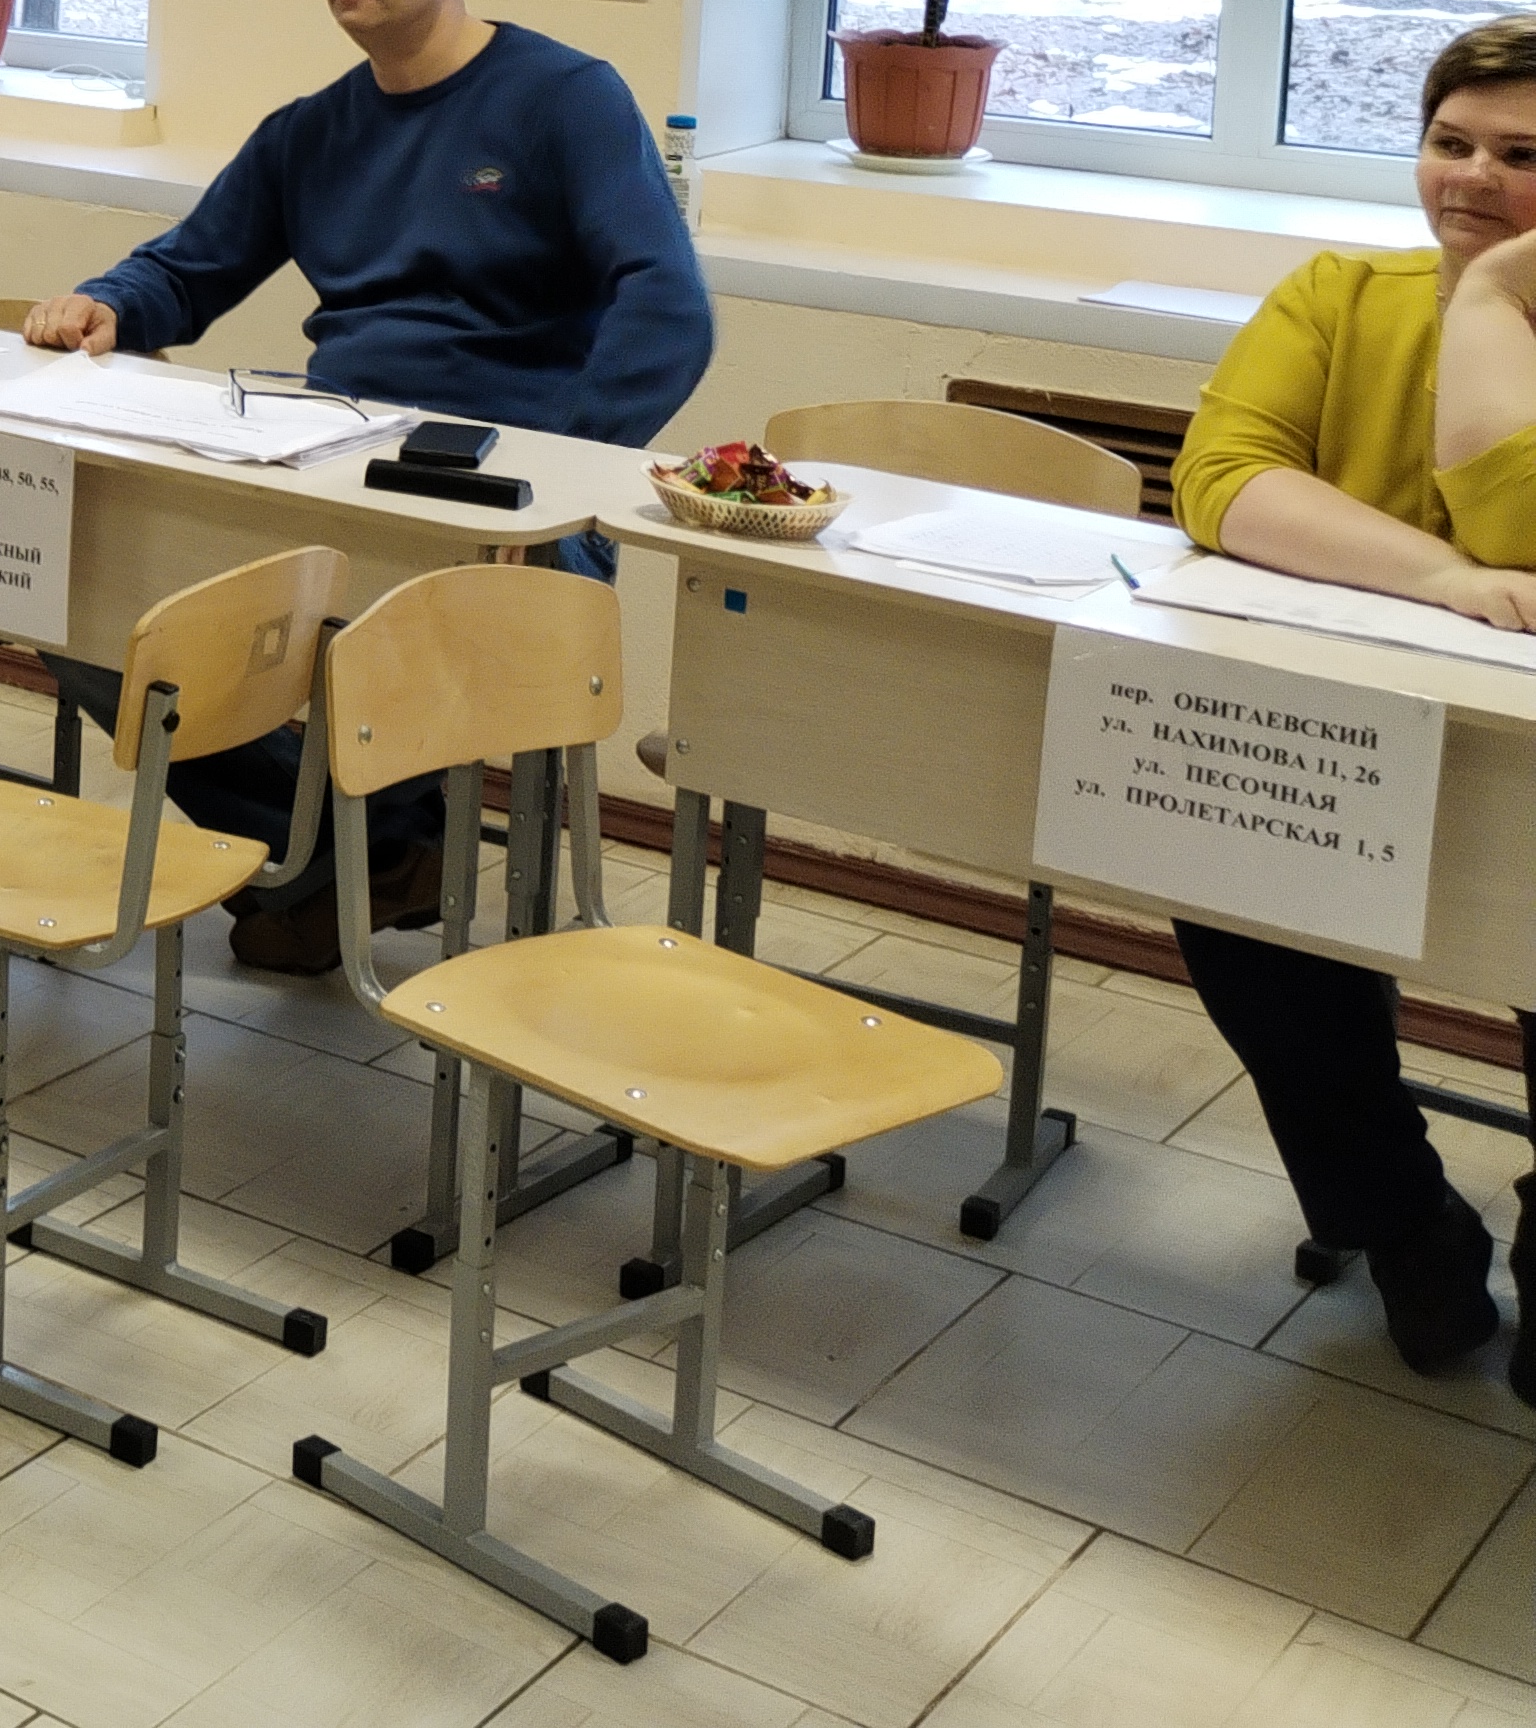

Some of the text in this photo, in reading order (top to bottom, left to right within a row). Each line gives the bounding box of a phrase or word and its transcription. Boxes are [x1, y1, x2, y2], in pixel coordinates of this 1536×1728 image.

[17, 472, 37, 491] 50,
[39, 477, 60, 496] 55,
[1100, 713, 1381, 787] ул. НАХИМОВА 11, 26
[1110, 681, 1379, 751] пер. ОБИТАЕВСКИЙ
[1132, 755, 1338, 814] ул. ПЕСОЧНАЯ
[1074, 777, 1395, 863] ул. ПРОЛЕТАРСКАЯ 1, 5
